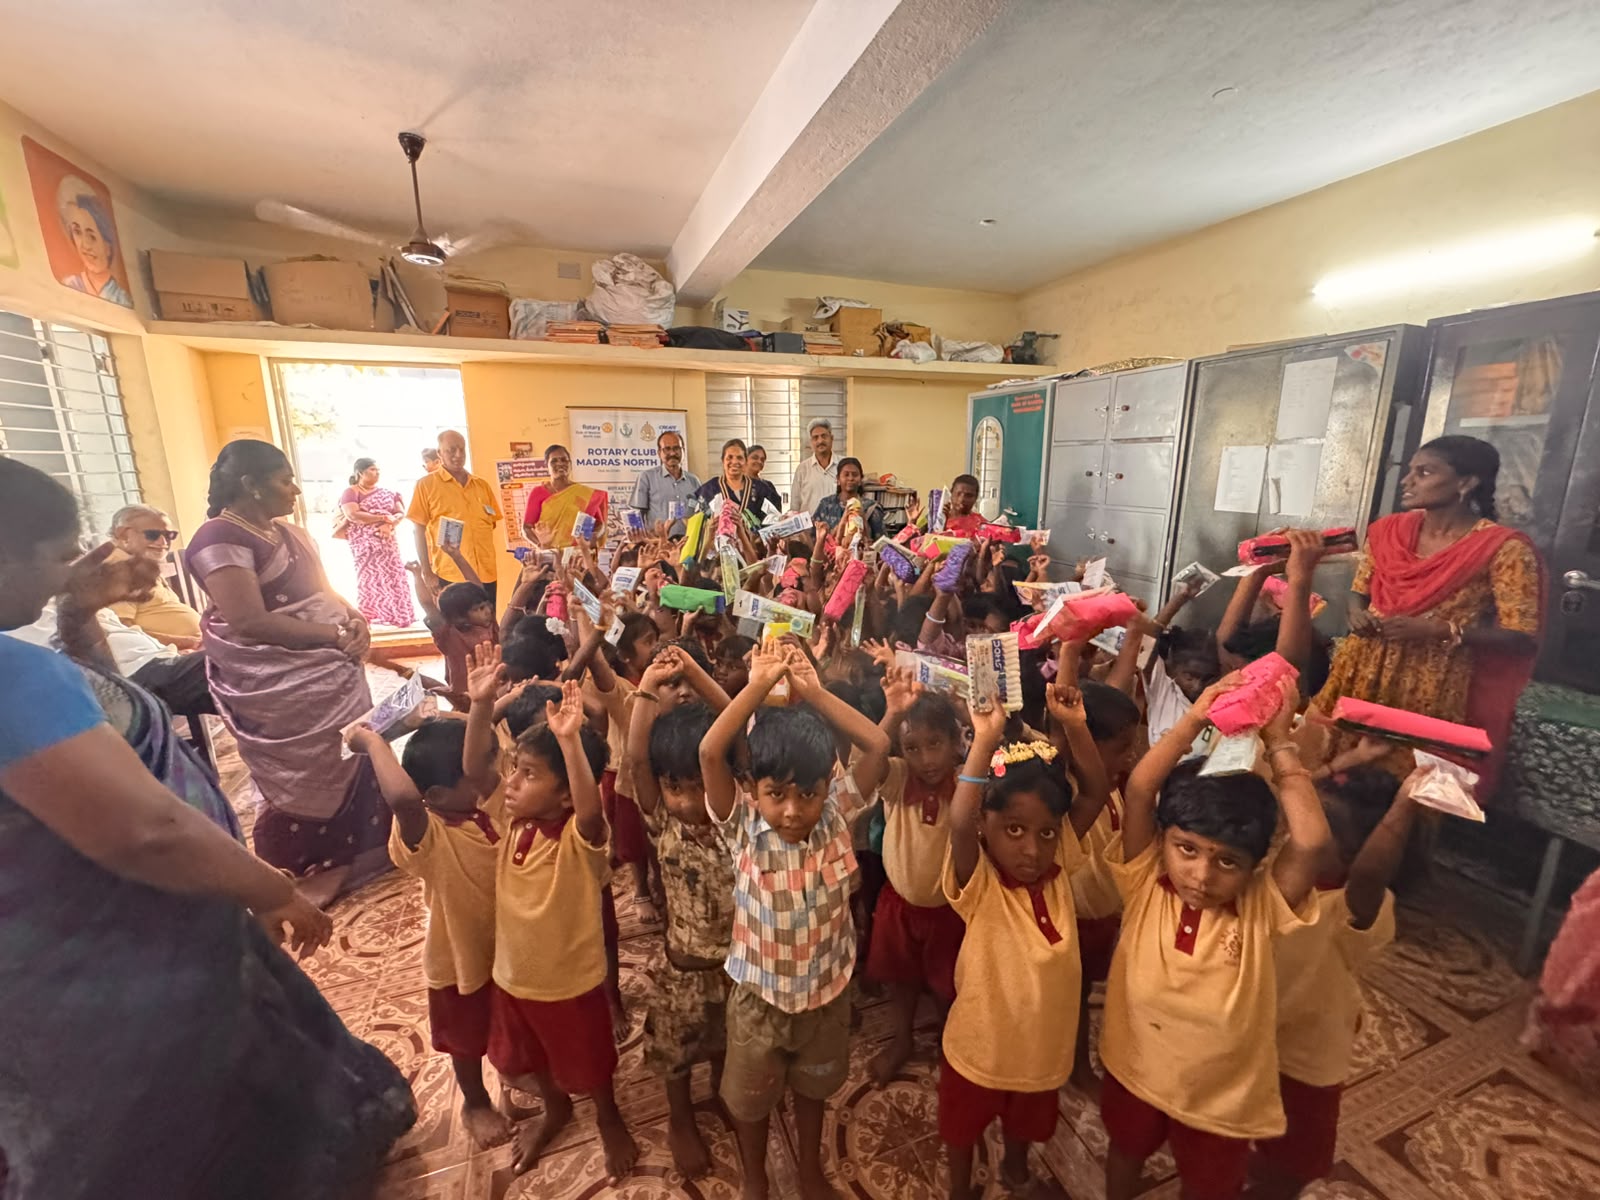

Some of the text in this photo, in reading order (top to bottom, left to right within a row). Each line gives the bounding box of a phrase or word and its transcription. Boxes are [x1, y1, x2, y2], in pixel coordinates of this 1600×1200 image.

[582, 424, 601, 432] Rotary
[587, 448, 657, 456] ROTARY CLUB
